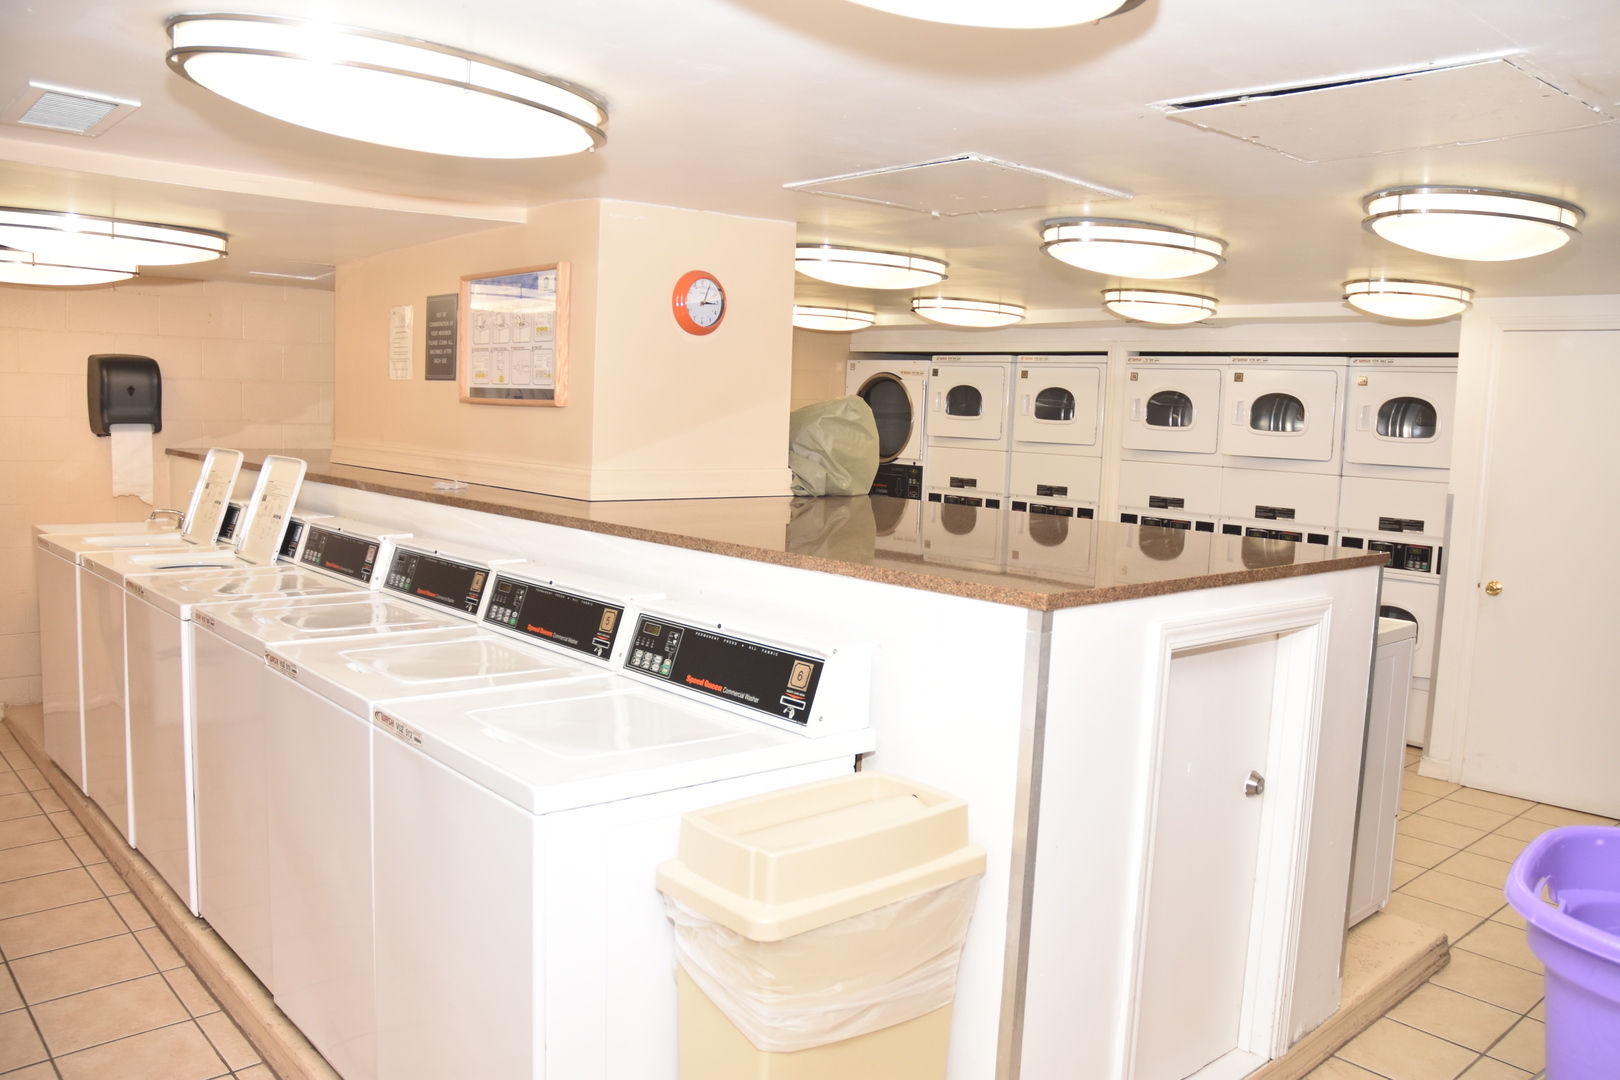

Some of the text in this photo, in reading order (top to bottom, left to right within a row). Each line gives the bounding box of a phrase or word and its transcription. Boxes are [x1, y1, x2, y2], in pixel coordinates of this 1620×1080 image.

[606, 616, 611, 625] 5
[540, 628, 553, 637] Queen
[695, 631, 720, 641] PERMANENT
[797, 671, 804, 681] 6
[686, 674, 760, 703] Speed Queen Commercial Washer
